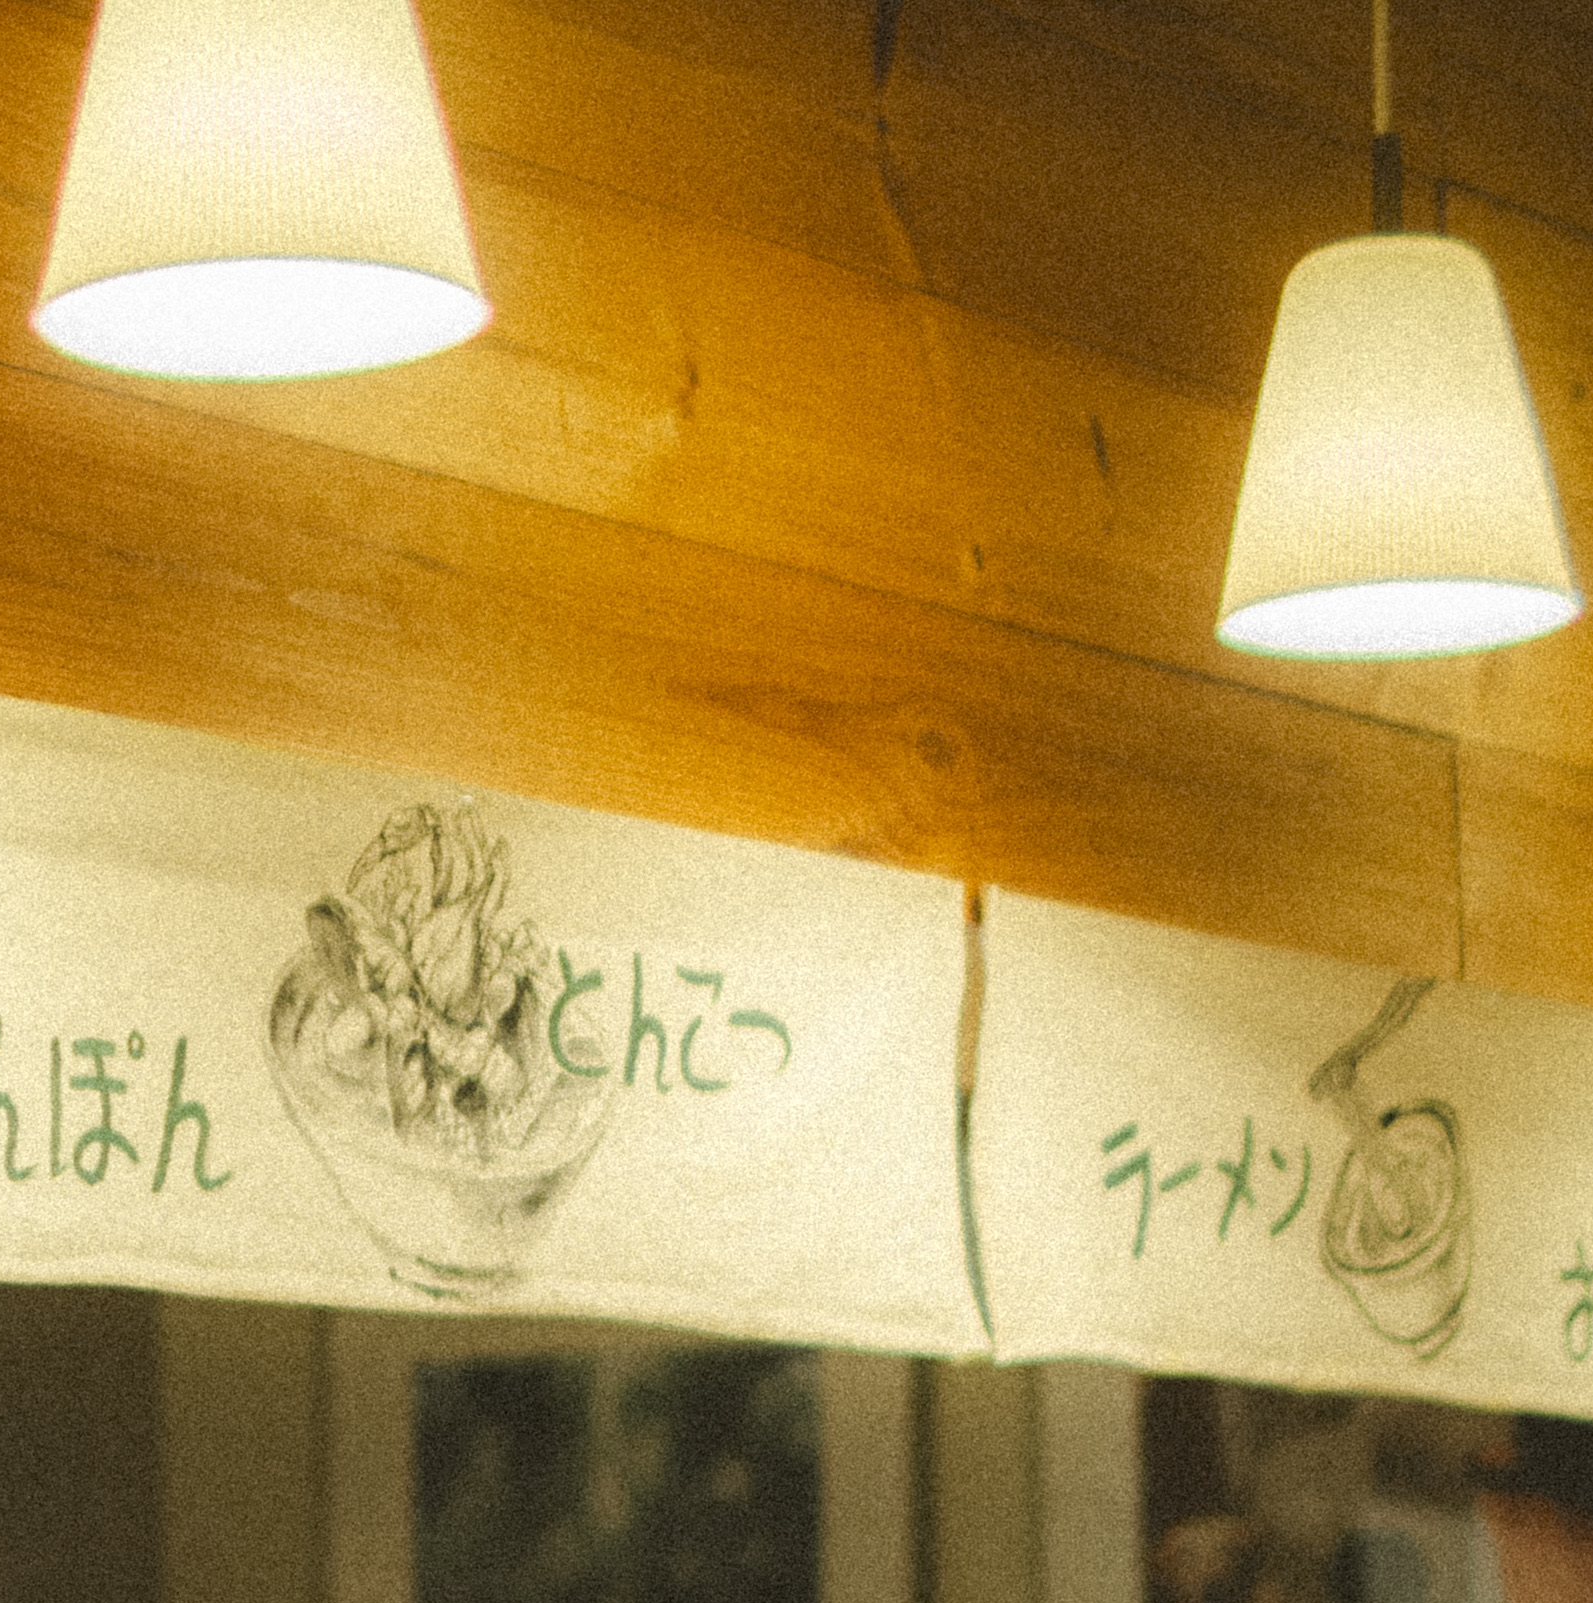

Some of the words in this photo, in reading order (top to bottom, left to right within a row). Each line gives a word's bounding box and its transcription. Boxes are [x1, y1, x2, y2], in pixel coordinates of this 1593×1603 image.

[548, 948, 793, 1095] とんこつ
[1102, 1116, 1312, 1260] ラーメン
